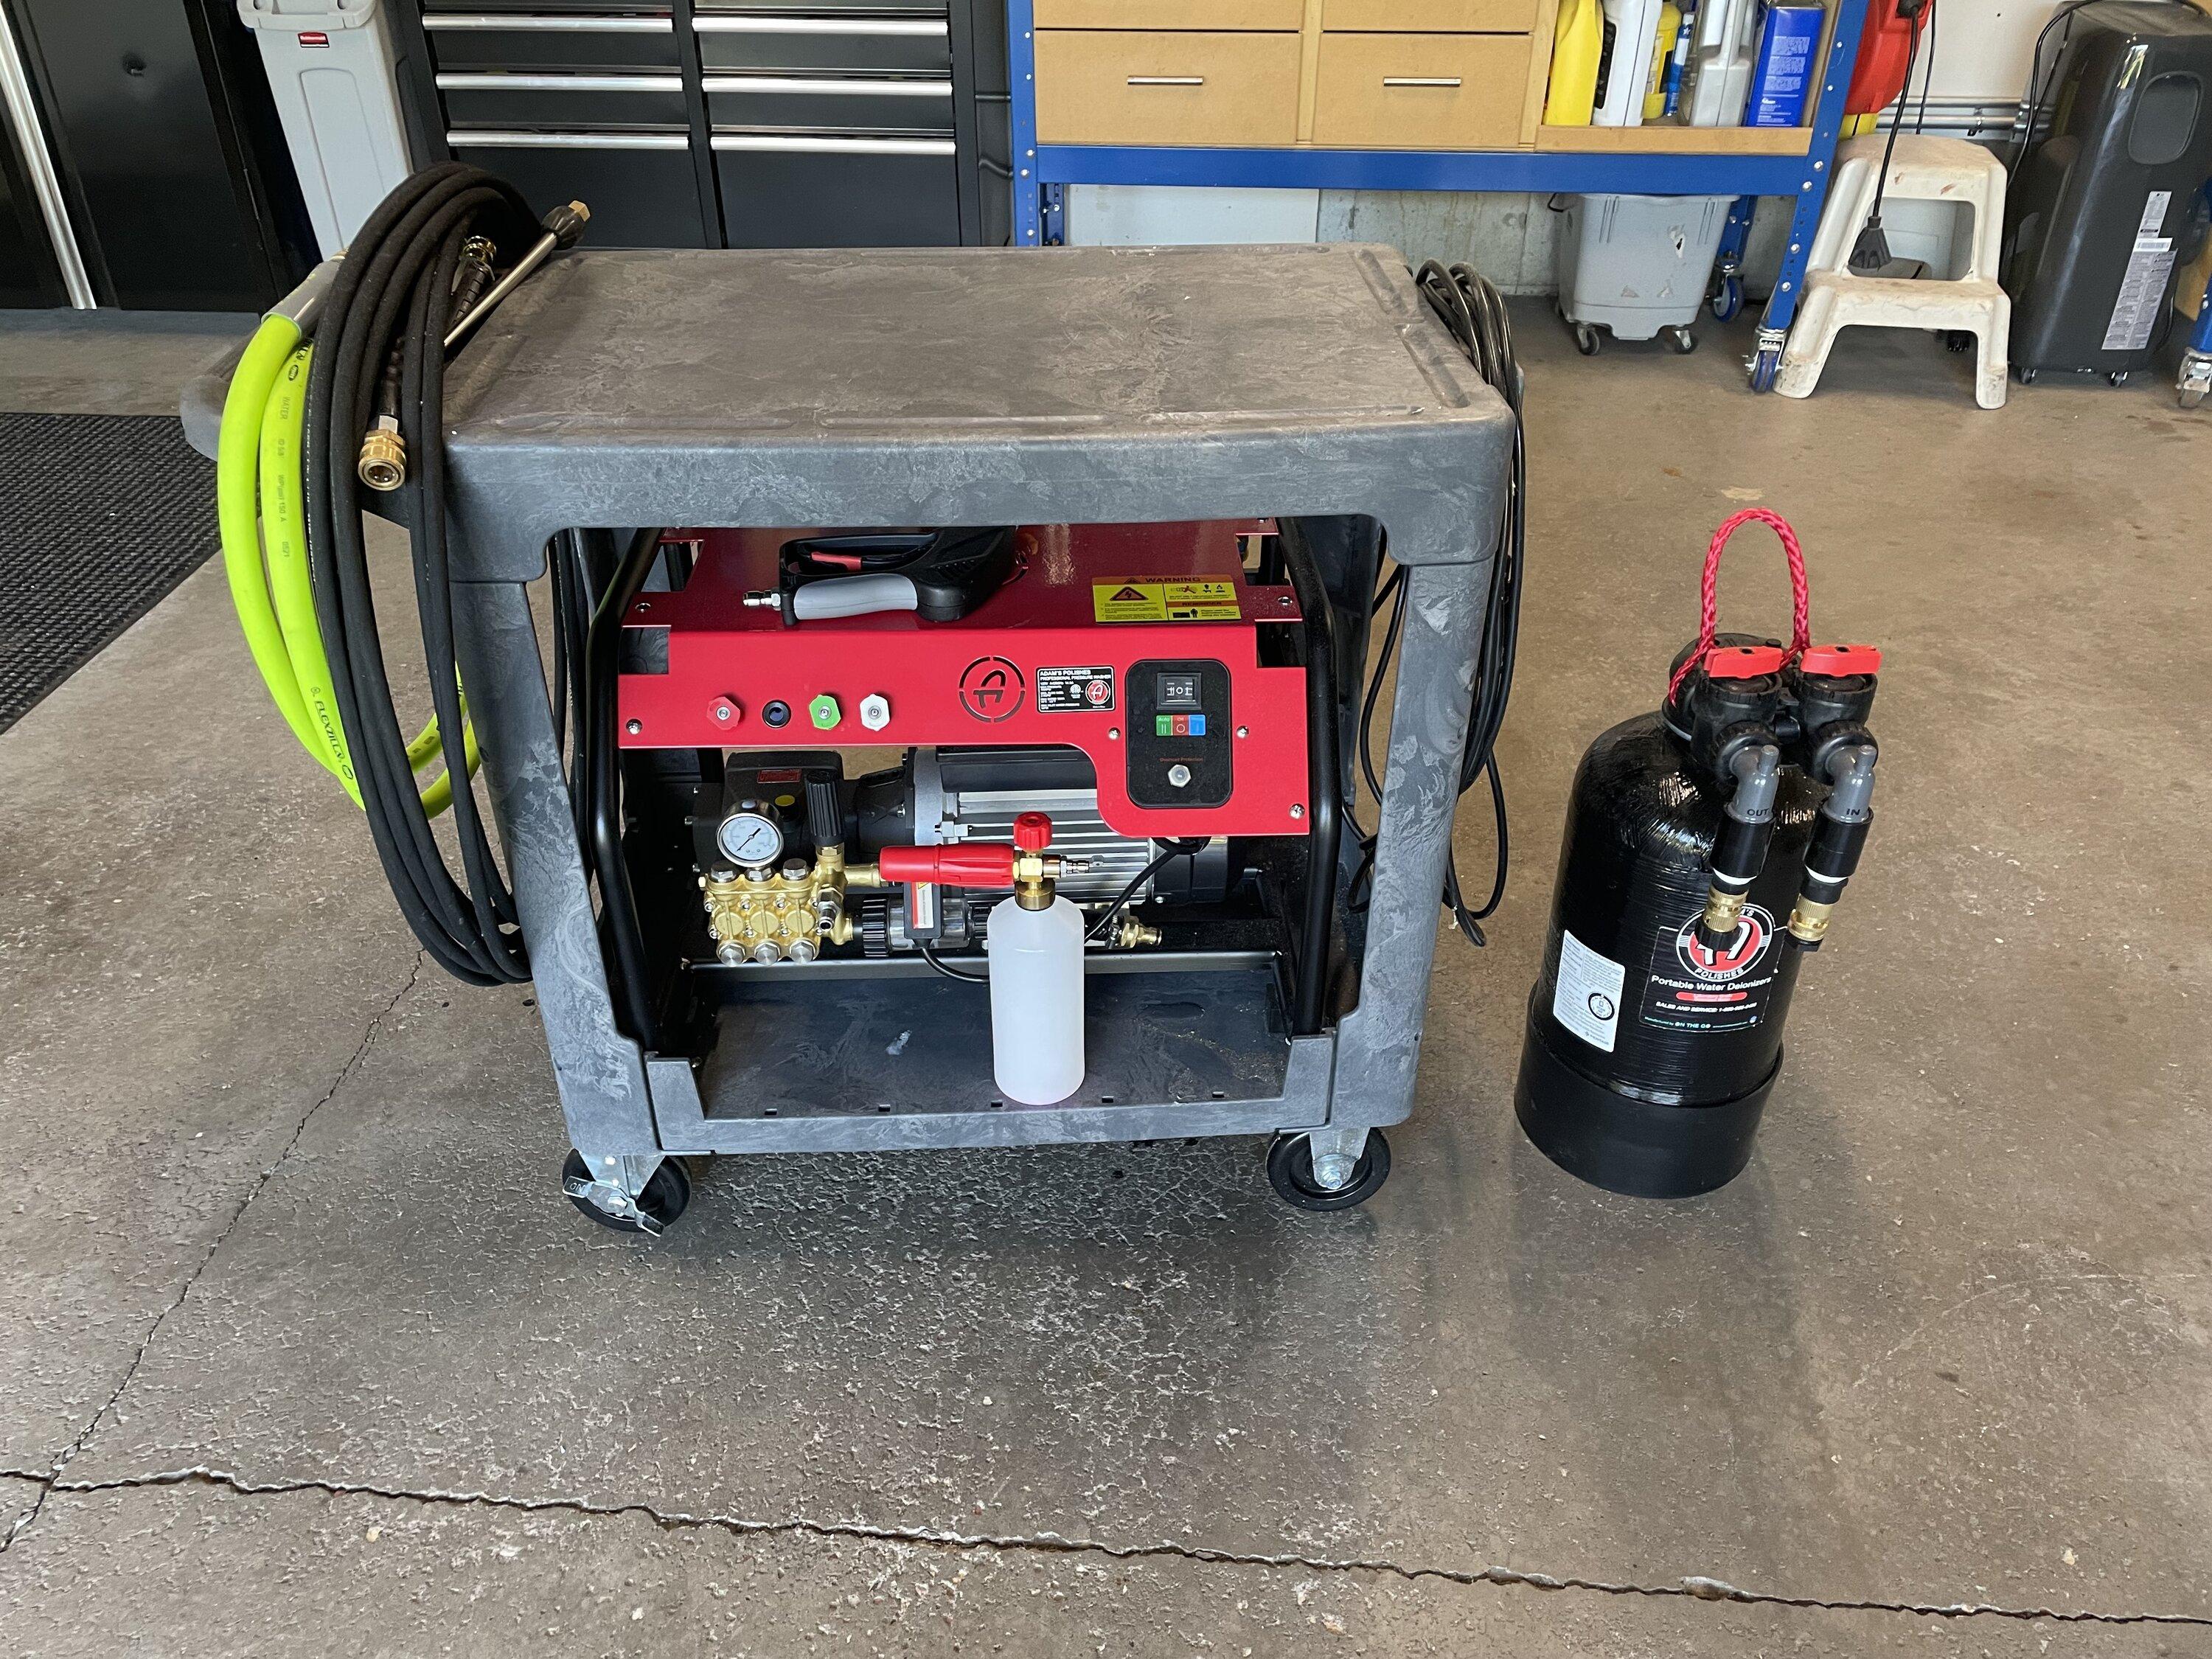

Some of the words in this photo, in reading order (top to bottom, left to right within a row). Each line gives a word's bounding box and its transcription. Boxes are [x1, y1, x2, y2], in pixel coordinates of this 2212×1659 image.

[280, 397, 291, 420] WATER
[315, 700, 345, 759] FLEXZILLA
[1747, 807, 1770, 816] OUT
[1694, 967, 1745, 980] POLISHES
[1651, 975, 1694, 990] Portable
[1697, 982, 1726, 992] Water
[1727, 976, 1773, 991] Deionizers
[1655, 1001, 1676, 1009] SALES
[569, 1182, 585, 1193] ON
